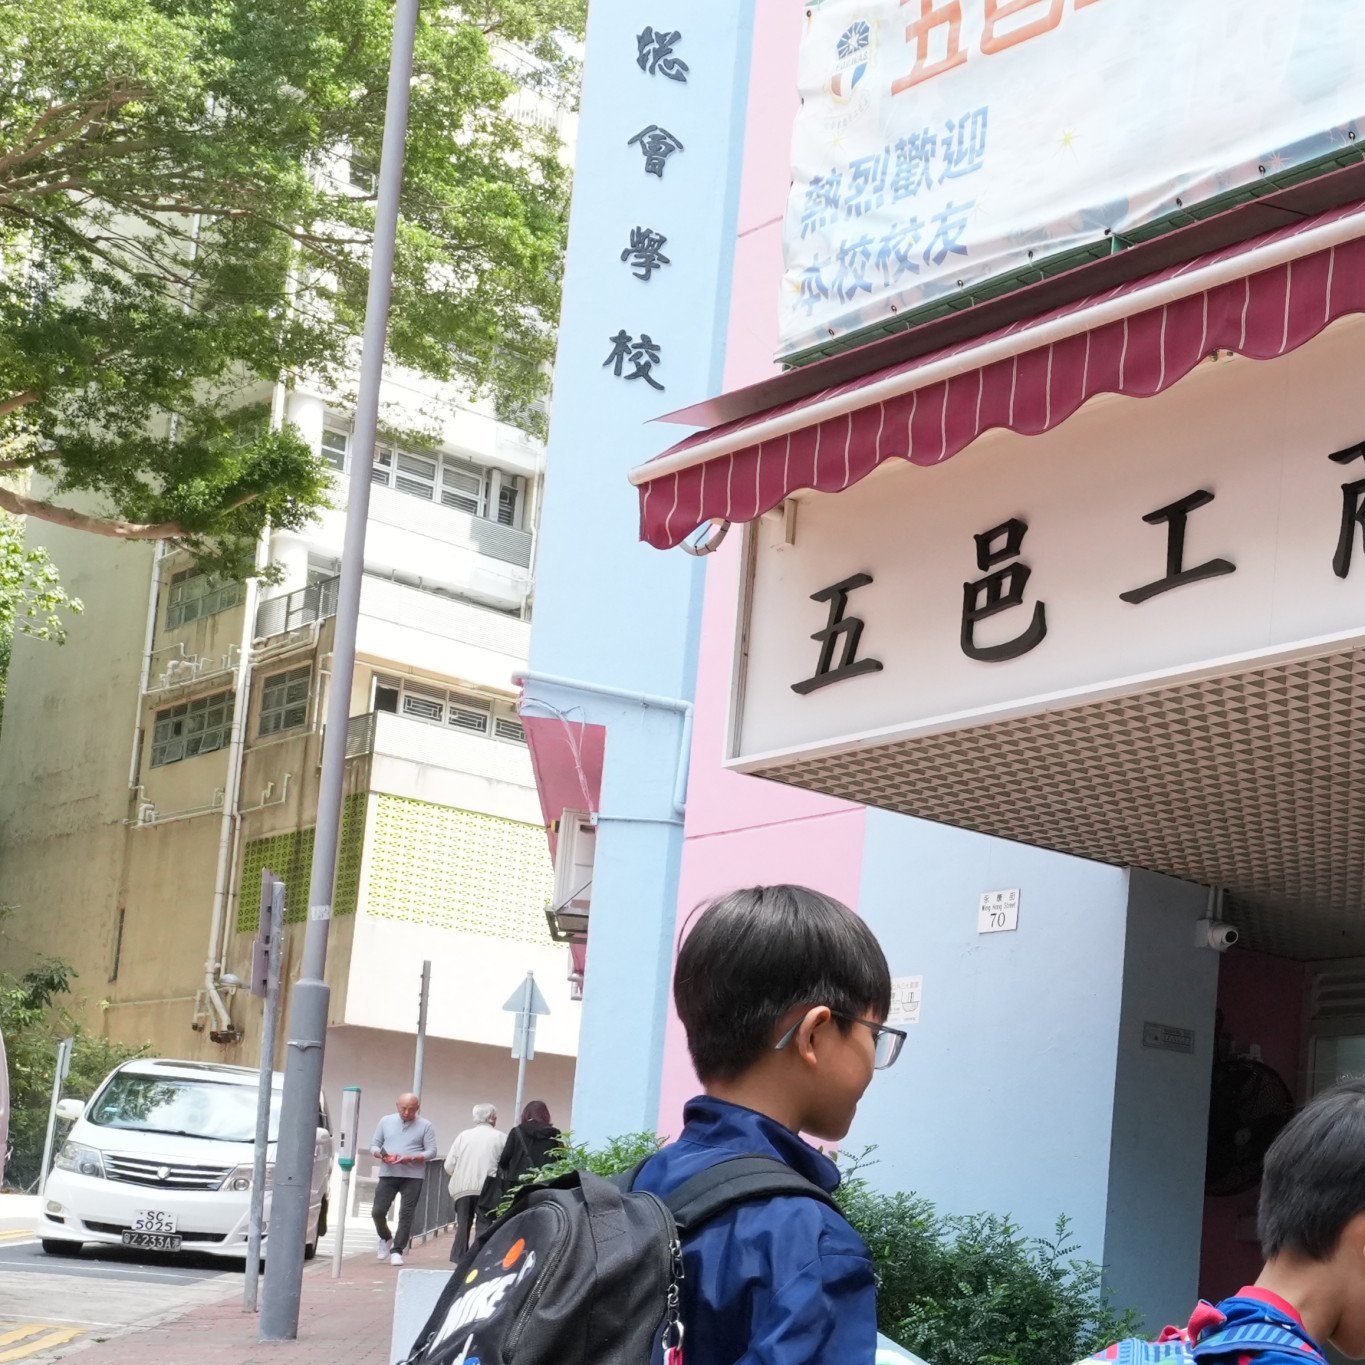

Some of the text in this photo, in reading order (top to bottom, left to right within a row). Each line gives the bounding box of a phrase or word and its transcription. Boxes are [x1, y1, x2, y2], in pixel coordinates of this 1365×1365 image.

[800, 105, 989, 240] 熱烈歡迎
[793, 198, 977, 317] 本校校友
[990, 912, 1006, 928] 70
[135, 1219, 174, 1232] 5025
[146, 1210, 165, 1222] SC
[427, 1272, 519, 1356] NIKE
